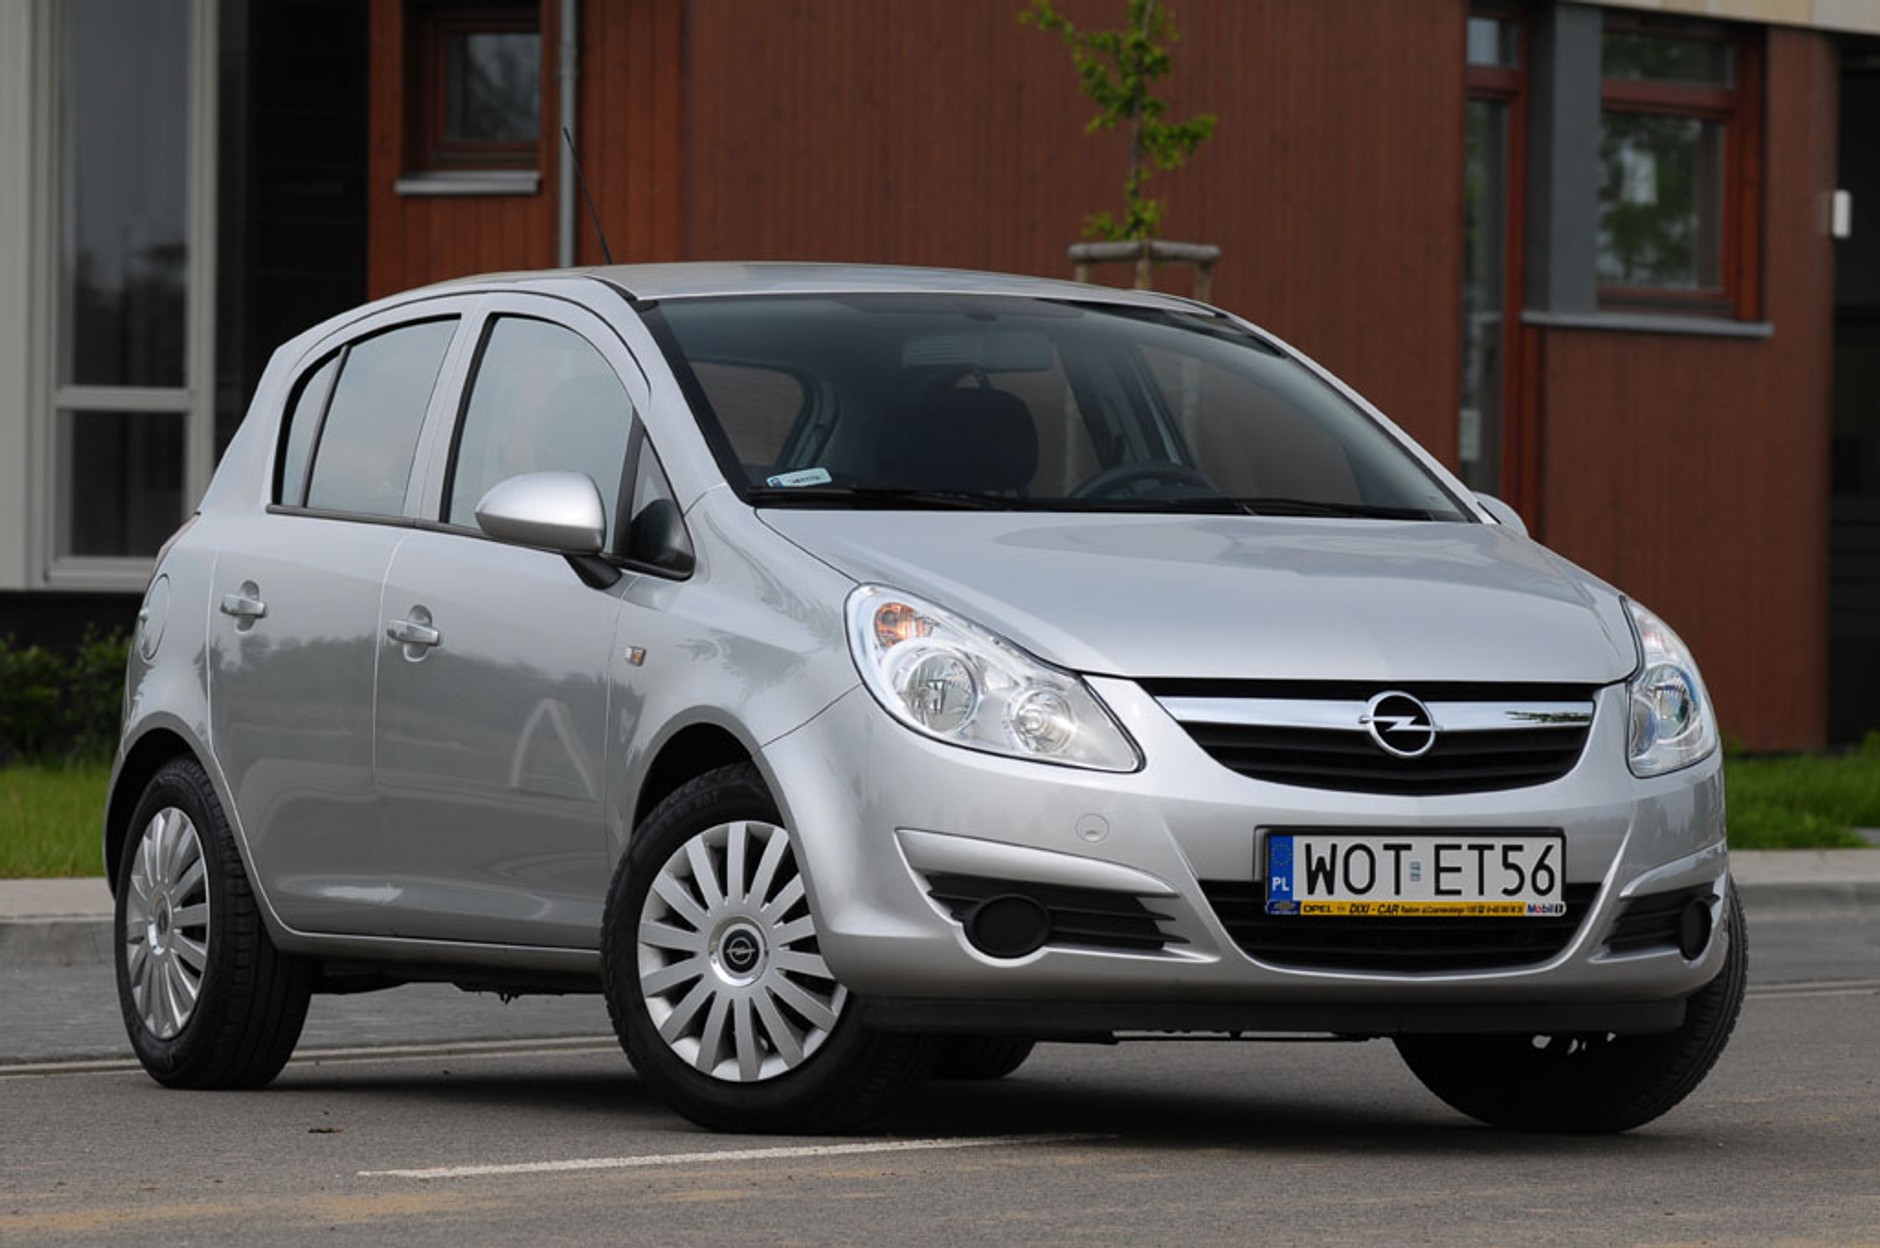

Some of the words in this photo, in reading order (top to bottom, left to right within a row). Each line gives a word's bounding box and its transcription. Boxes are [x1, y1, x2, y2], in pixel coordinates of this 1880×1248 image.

[1304, 843, 1412, 896] WOT
[1434, 843, 1556, 897] ET56
[1271, 877, 1290, 891] PL
[1303, 904, 1333, 913] OPEL
[1377, 903, 1400, 914] CAR
[1527, 903, 1553, 914] Mobil
